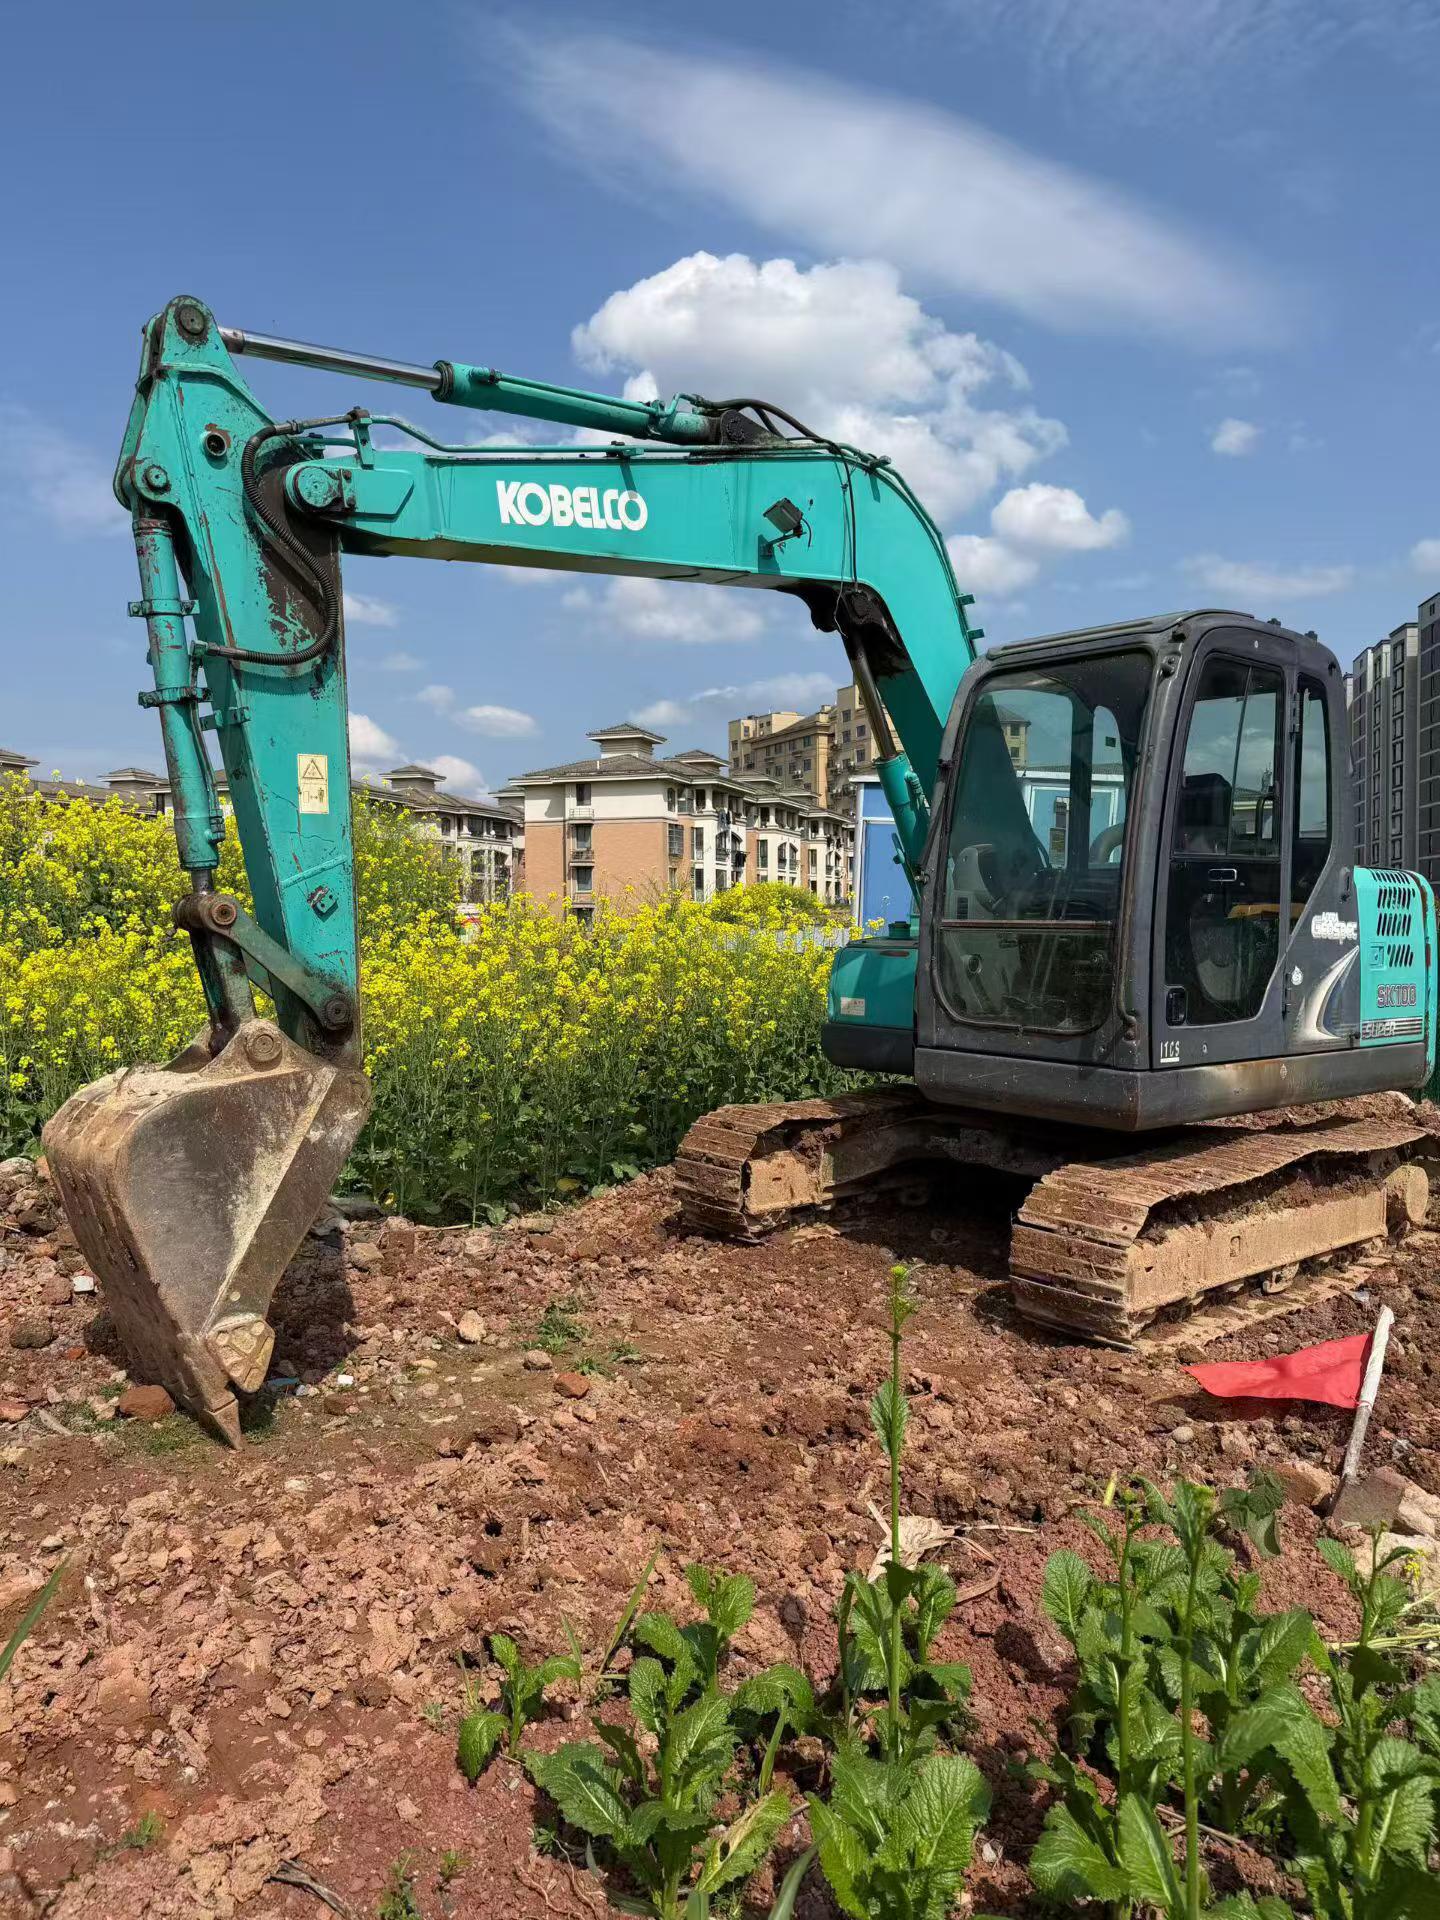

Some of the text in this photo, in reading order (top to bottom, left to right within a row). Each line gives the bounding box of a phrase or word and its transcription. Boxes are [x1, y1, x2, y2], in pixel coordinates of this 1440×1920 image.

[496, 480, 648, 531] KOBELCO
[1377, 984, 1416, 1008] SK100
[1362, 1021, 1396, 1039] SUPER
[1160, 1040, 1180, 1058] ITCS
